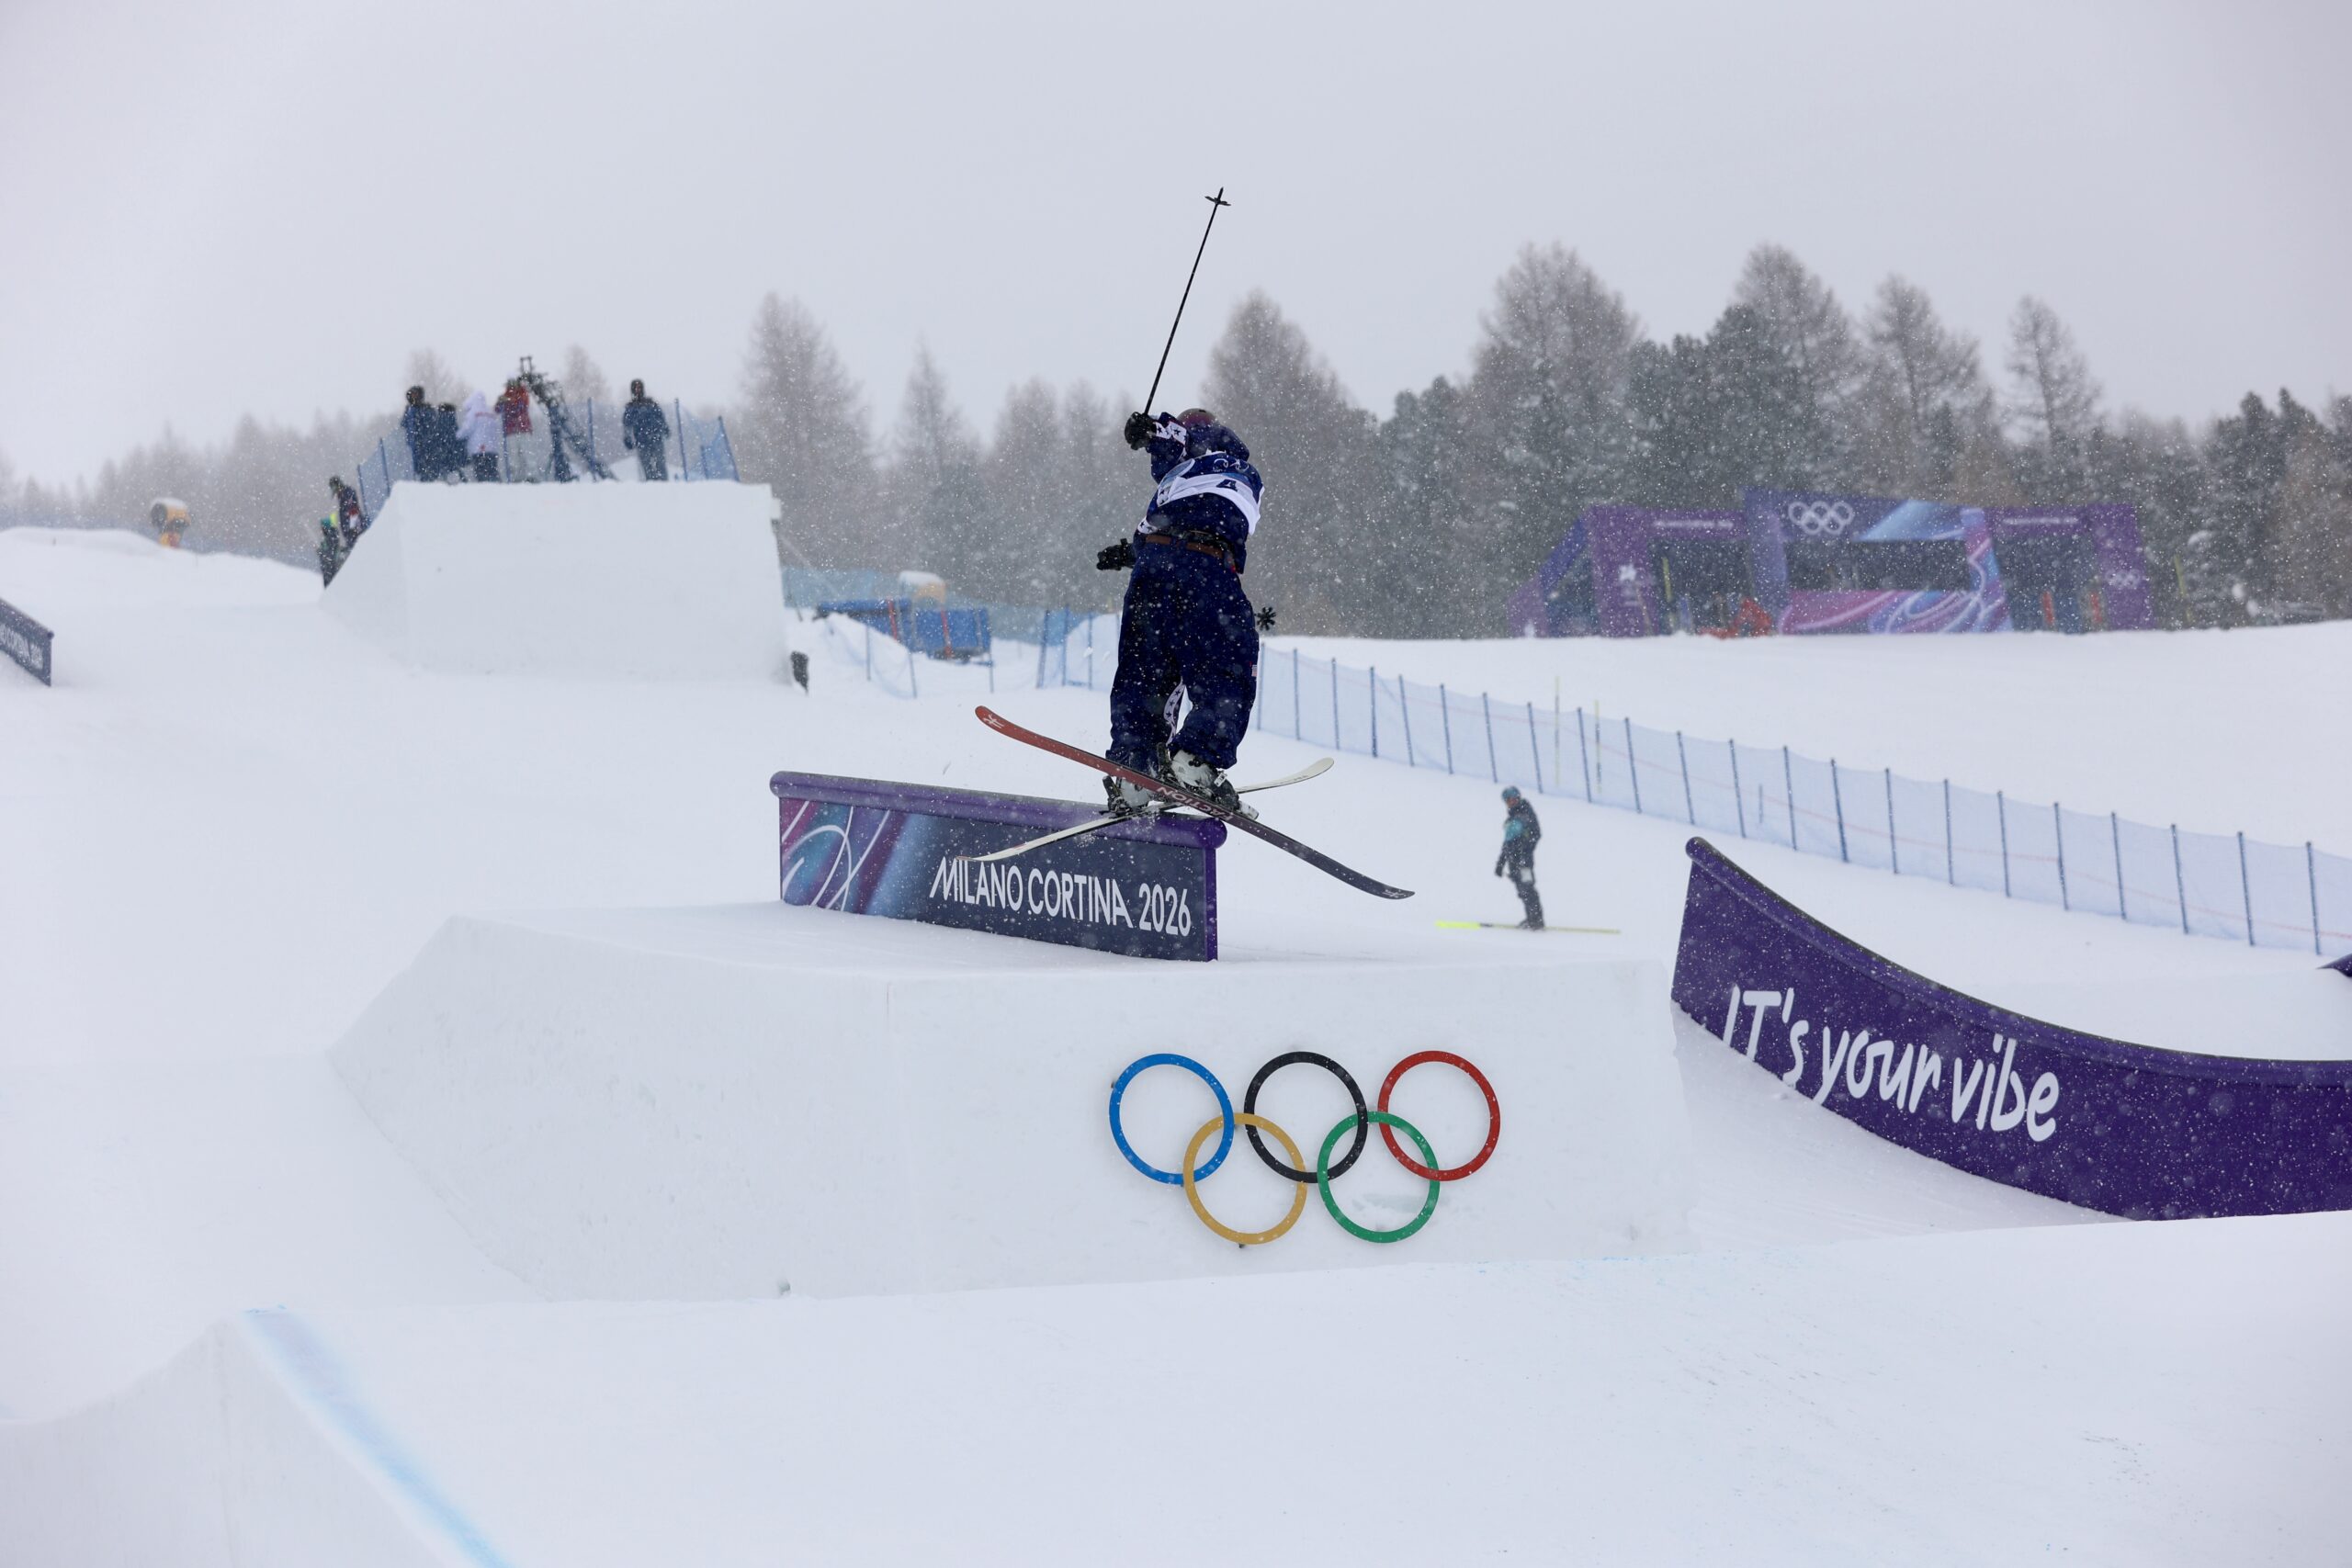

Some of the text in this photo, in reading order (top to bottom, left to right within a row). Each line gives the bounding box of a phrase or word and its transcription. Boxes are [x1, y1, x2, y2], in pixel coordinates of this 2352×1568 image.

[1158, 787, 1234, 820] FACTION
[929, 856, 1192, 936] MILANO CORTINA 2026
[1723, 985, 2059, 1142] IT's your vibe
